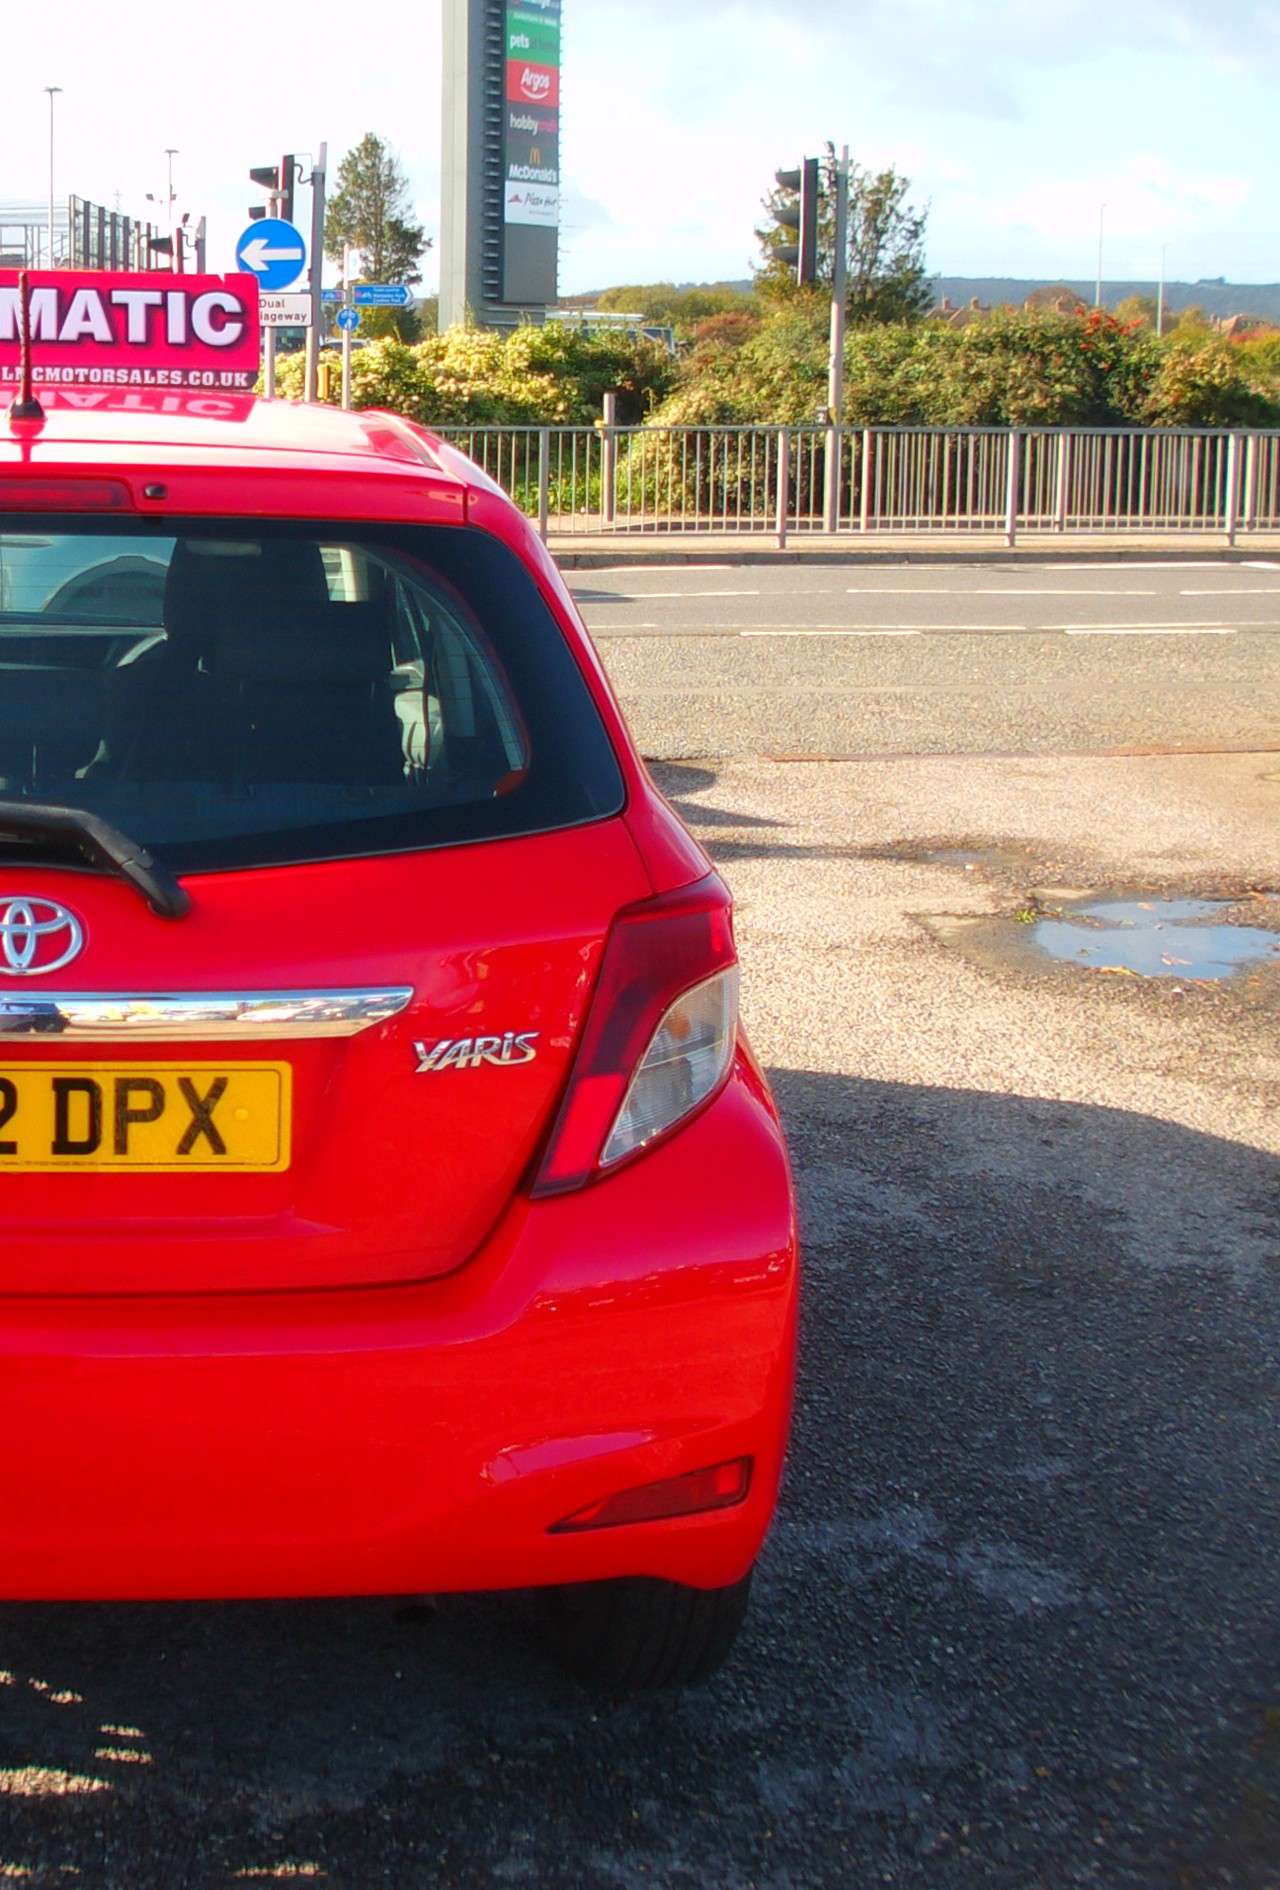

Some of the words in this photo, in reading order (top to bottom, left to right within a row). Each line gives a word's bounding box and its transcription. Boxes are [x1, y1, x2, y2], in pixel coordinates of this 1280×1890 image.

[521, 67, 550, 92] Argos
[509, 164, 557, 183] McDonald's
[259, 298, 285, 308] Dual
[51, 1076, 229, 1156] DPX
